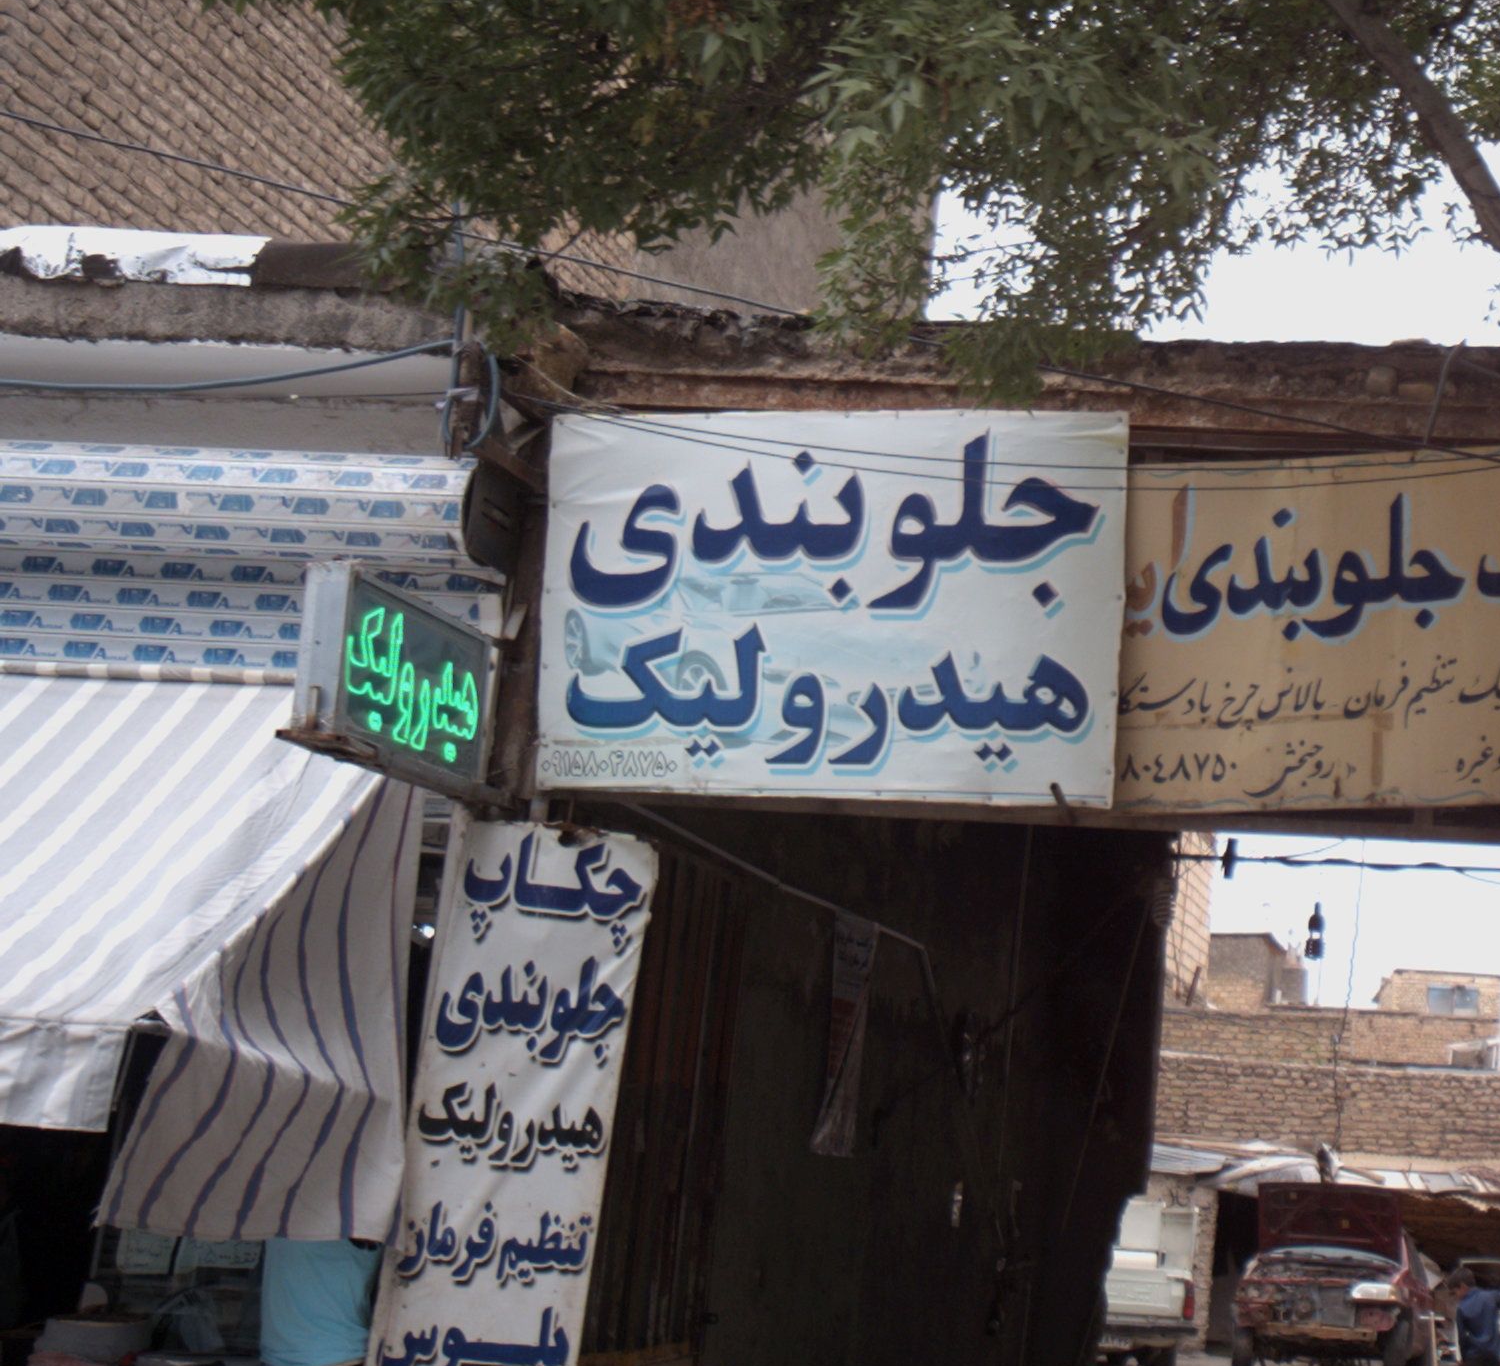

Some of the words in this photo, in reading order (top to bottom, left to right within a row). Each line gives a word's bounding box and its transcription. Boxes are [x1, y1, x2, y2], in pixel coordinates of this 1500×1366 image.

[569, 428, 1100, 610] جلوبندی
[345, 607, 479, 762] هیدرولیک
[566, 623, 1091, 766] هیدرولیک
[1216, 681, 1260, 731] چرخ
[1258, 667, 1325, 720] بالانس
[1344, 661, 1410, 719] فرمان
[1404, 655, 1457, 730] تنظیم
[541, 749, 678, 777] ۰۹۱۵۸۰۴۸۷۵۰
[1455, 735, 1493, 783] غیره
[464, 831, 643, 947] چکاپ
[436, 956, 626, 1060] جلوبندی
[418, 1082, 604, 1167] هیدرولیک
[398, 1201, 496, 1279] فرمان
[497, 1211, 592, 1280] تنظیم
